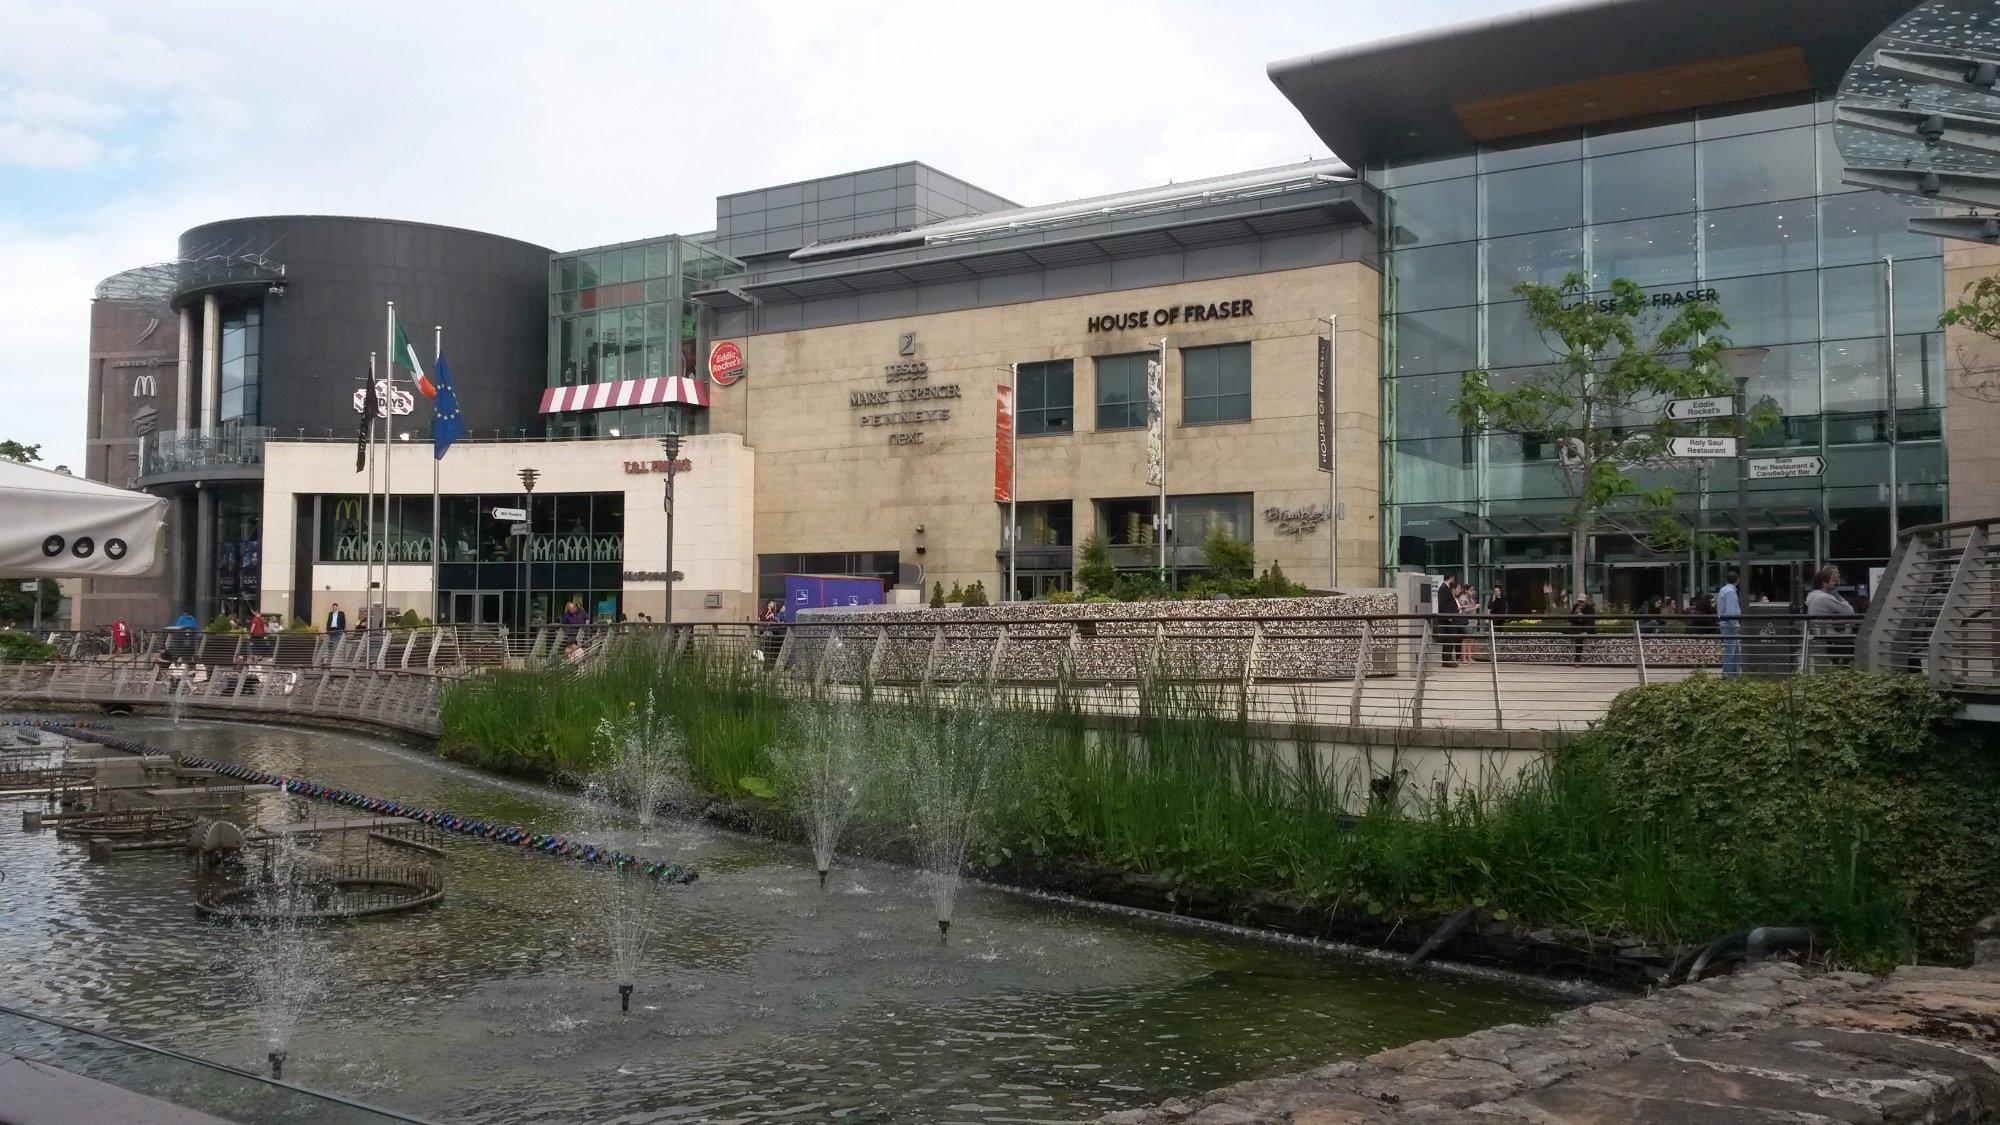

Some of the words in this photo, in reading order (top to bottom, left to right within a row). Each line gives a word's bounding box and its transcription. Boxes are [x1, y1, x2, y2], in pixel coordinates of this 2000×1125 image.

[1652, 288, 1716, 307] FRASER
[1088, 311, 1149, 333] HOUSE
[1153, 307, 1179, 326] OF
[1184, 299, 1253, 323] FRASER
[716, 350, 736, 363] Eddie
[885, 362, 928, 377] TESCO
[850, 391, 889, 406] MARKS
[910, 384, 962, 400] SPENCER
[1319, 397, 1325, 415] OF
[1687, 407, 1720, 415] Rocket's
[860, 409, 951, 427] PENNEYS
[888, 432, 925, 446] next
[1319, 420, 1327, 463] HOUSE
[1690, 439, 1706, 447] Roly
